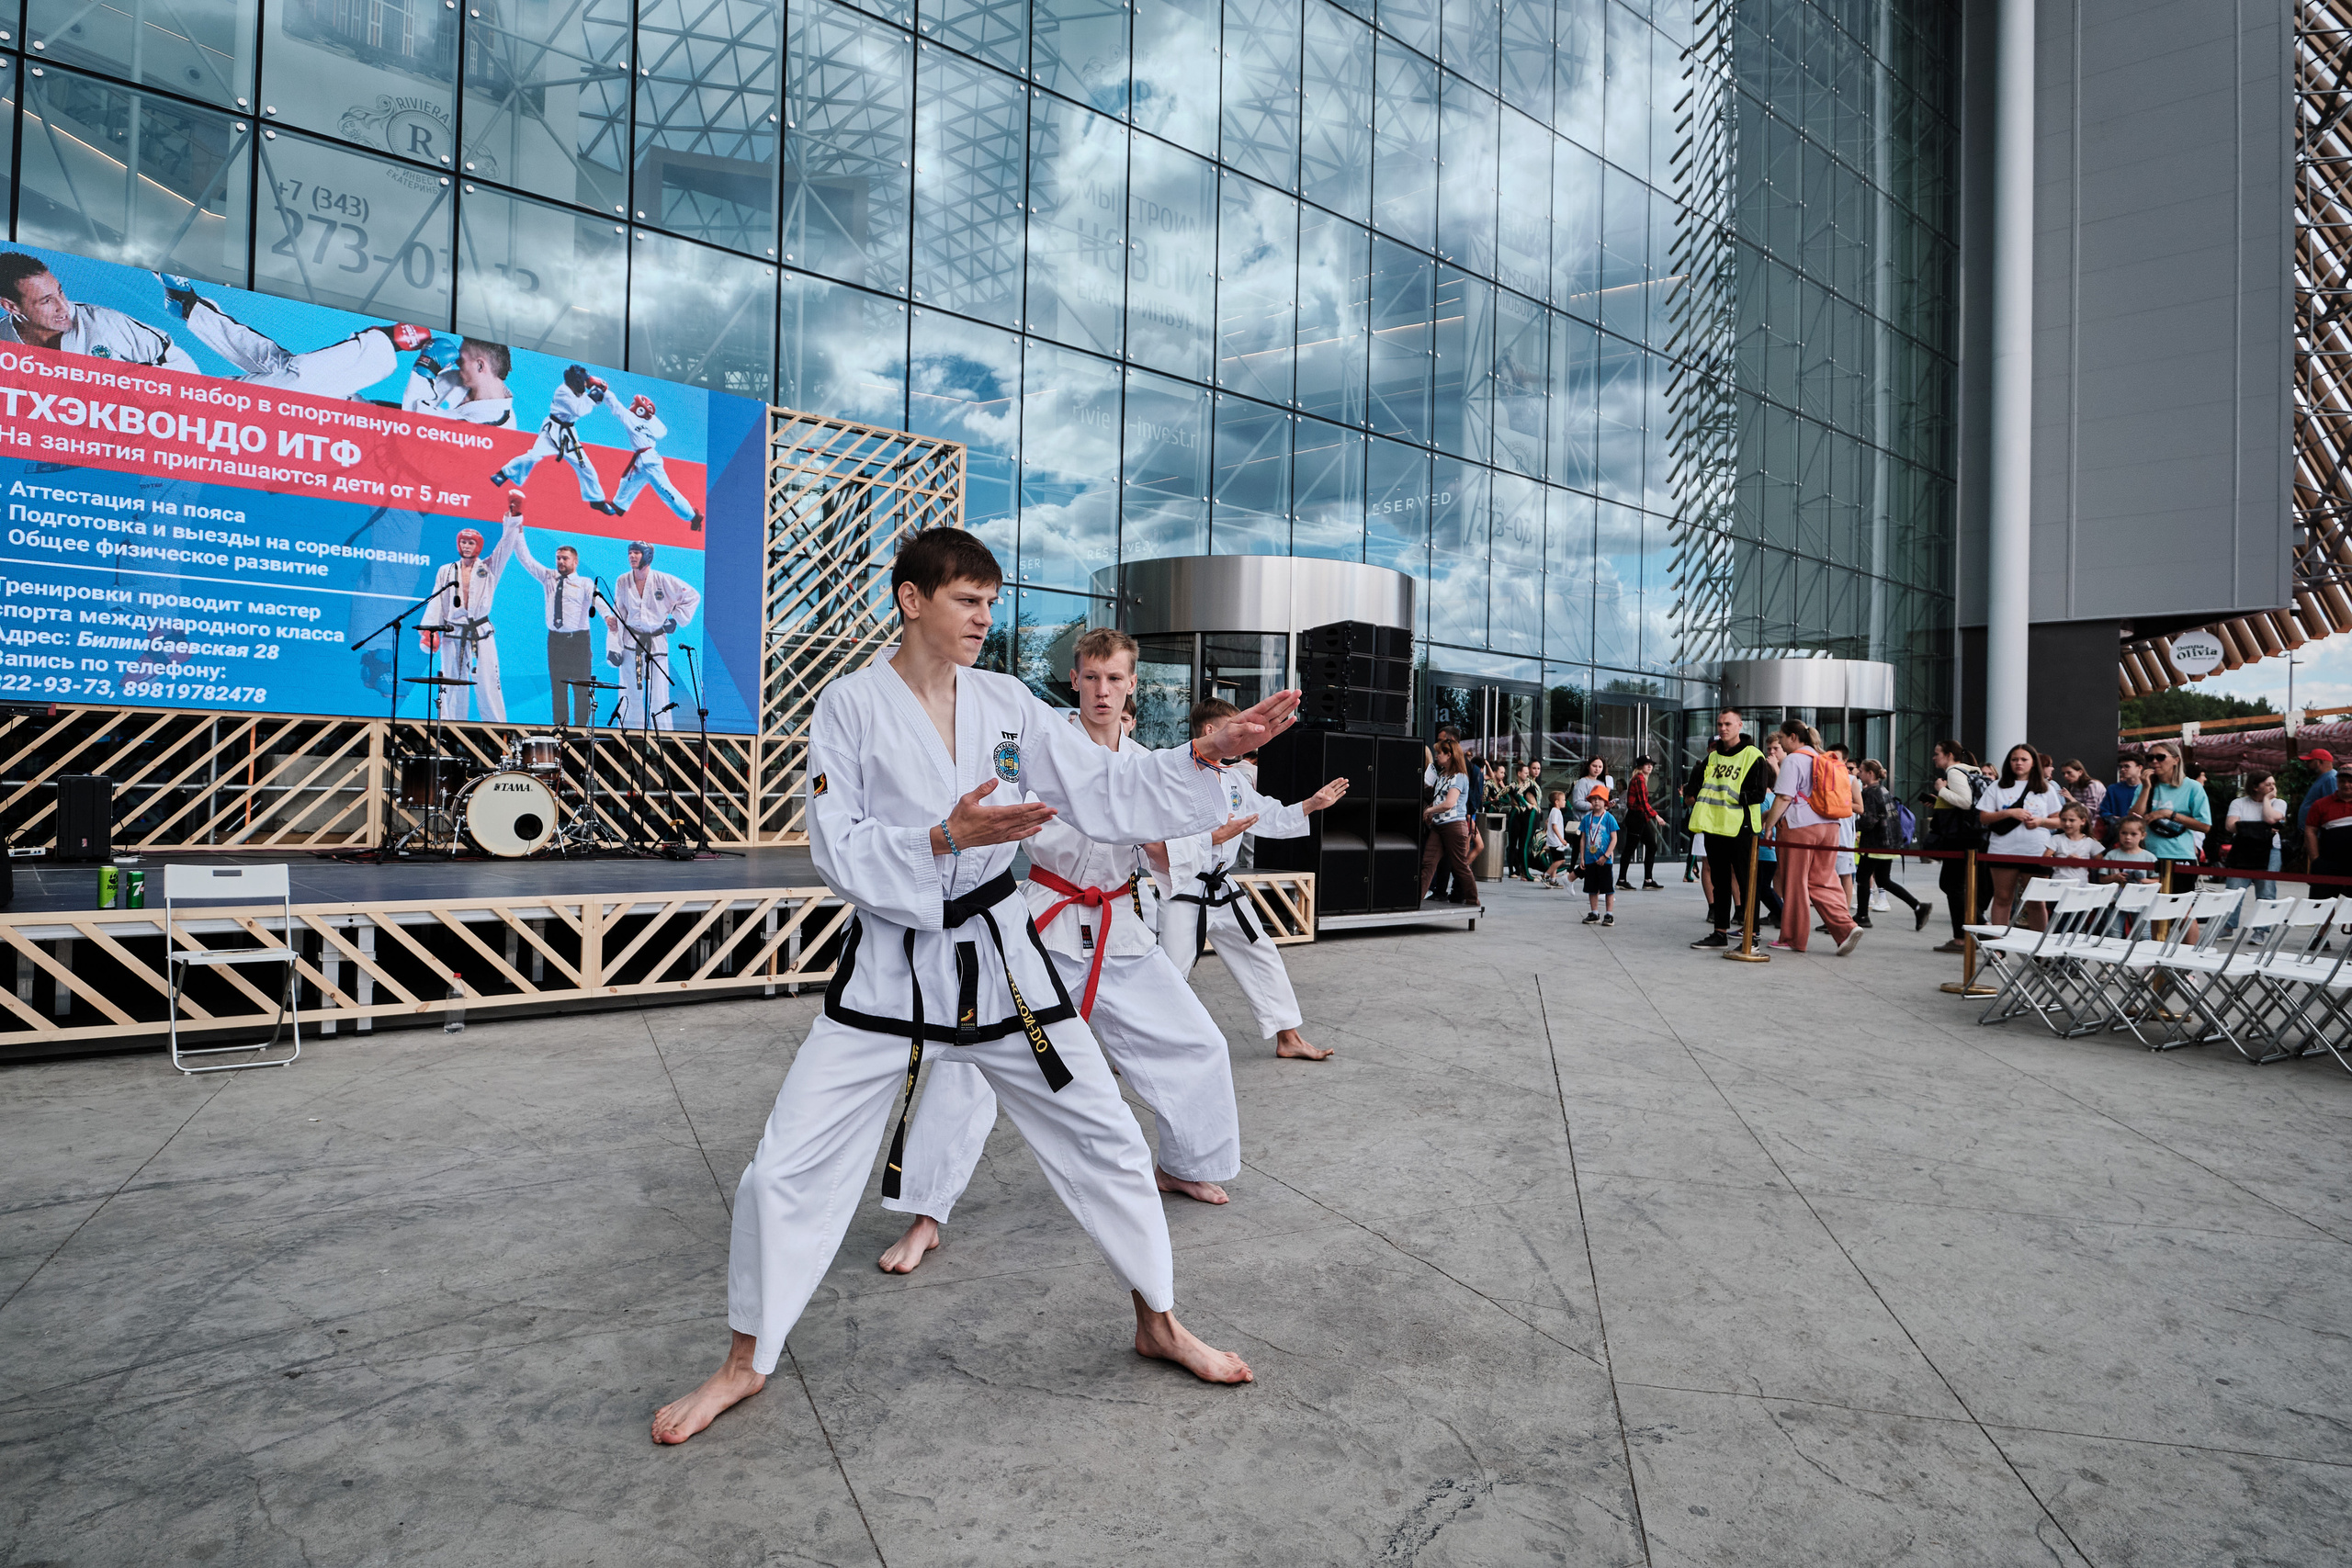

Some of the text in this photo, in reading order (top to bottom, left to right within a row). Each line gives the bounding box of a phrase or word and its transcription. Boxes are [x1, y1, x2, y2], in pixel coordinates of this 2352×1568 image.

[396, 96, 450, 124] RIVIERA
[407, 123, 436, 159] R
[277, 179, 369, 223] +7 (343)
[0, 352, 494, 450] Объявляется набор в спортивную секцию
[0, 386, 362, 468] ТХЭКВОНДО ИТФ
[0, 424, 32, 447] На
[40, 434, 145, 462] занятия
[153, 450, 327, 487] приглашаются
[333, 477, 385, 496] дети
[390, 483, 414, 500] от
[419, 485, 432, 502] 5
[436, 490, 471, 508] лет
[9, 480, 145, 511] Аттестация
[152, 500, 177, 515] на
[184, 503, 246, 524] пояса
[9, 504, 430, 566] Подготовка и выезды на соревнования
[8, 528, 329, 577] Общее физическое развитие
[139, 592, 243, 614] проводит
[248, 602, 321, 622] мастер
[79, 610, 270, 637] международного
[277, 626, 345, 643] класса
[77, 630, 249, 658] Билимбаевская
[254, 644, 280, 660] 28
[2177, 647, 2218, 660] Olivia
[81, 658, 108, 671] по
[115, 660, 226, 682] телефону:
[0, 674, 266, 704] 22-93-73, 89819782478
[1001, 730, 1019, 741] ITF
[500, 783, 531, 792] TAMA
[1712, 763, 1742, 781] 1285
